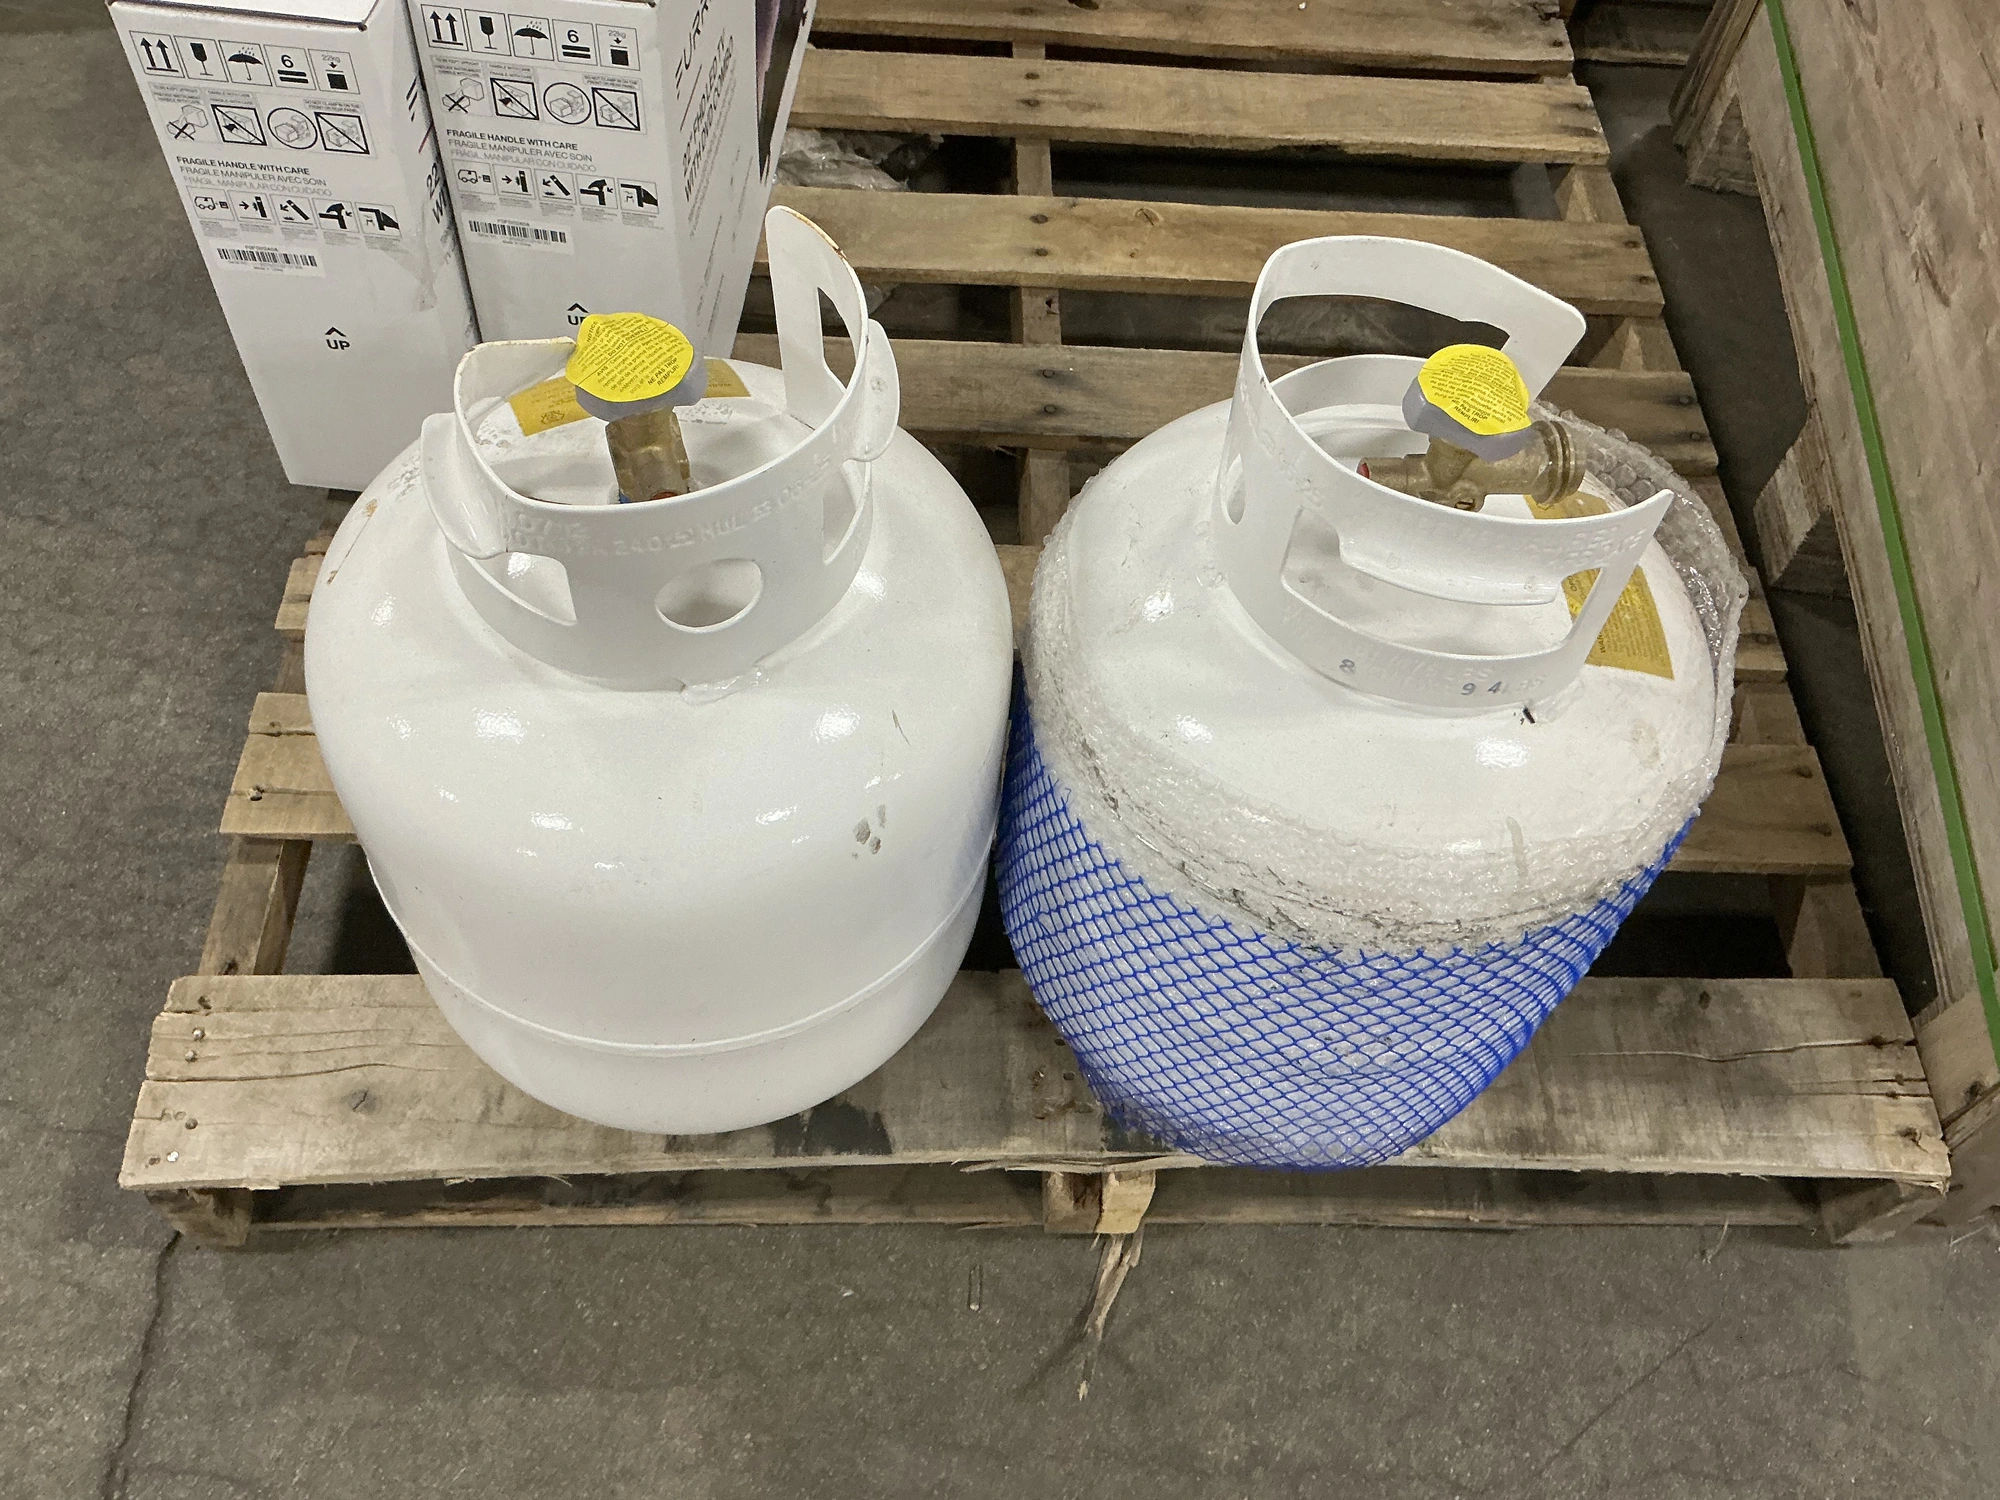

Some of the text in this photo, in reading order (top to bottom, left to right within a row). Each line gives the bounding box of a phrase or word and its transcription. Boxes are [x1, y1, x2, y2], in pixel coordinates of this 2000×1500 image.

[567, 29, 579, 43] 6
[281, 54, 294, 69] 6
[446, 129, 578, 151] FRAGILE HANDLE WITH CARE
[448, 139, 593, 162] FRAGILE MANIPULER AVEC SOIN
[176, 156, 310, 175] FRAGILE HANDLE WITH CARE
[179, 166, 327, 187] FRAGILE MANIPULER AVEC SOIN
[326, 339, 351, 350] UP
[614, 339, 625, 350] NOT
[596, 365, 608, 375] AVIS
[647, 356, 678, 385] NE PAS TROP
[656, 364, 680, 386] REMPLIR!
[1453, 405, 1479, 424] REMPLIR!
[1459, 403, 1470, 412] PAS
[1471, 410, 1488, 421] TROP
